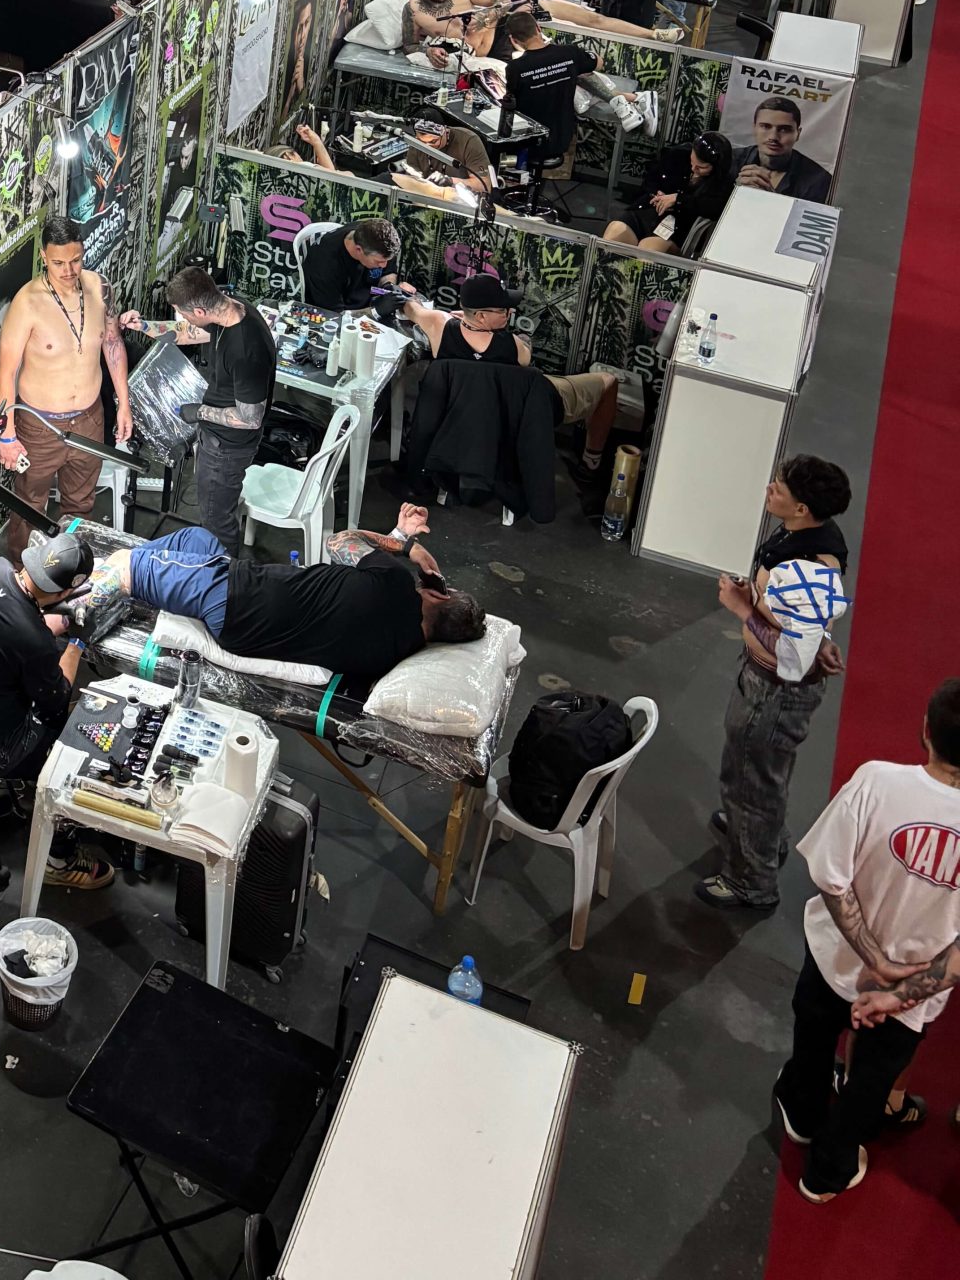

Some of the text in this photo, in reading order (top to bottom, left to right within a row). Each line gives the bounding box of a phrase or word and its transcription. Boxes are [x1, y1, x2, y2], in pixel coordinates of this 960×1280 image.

[740, 64, 831, 91] RAFAEL
[746, 79, 833, 104] LUZART
[395, 83, 426, 106] Pa
[790, 210, 839, 258] DAMI
[253, 240, 300, 268] Stu
[251, 262, 303, 297] Pay
[905, 827, 960, 890] VAN
